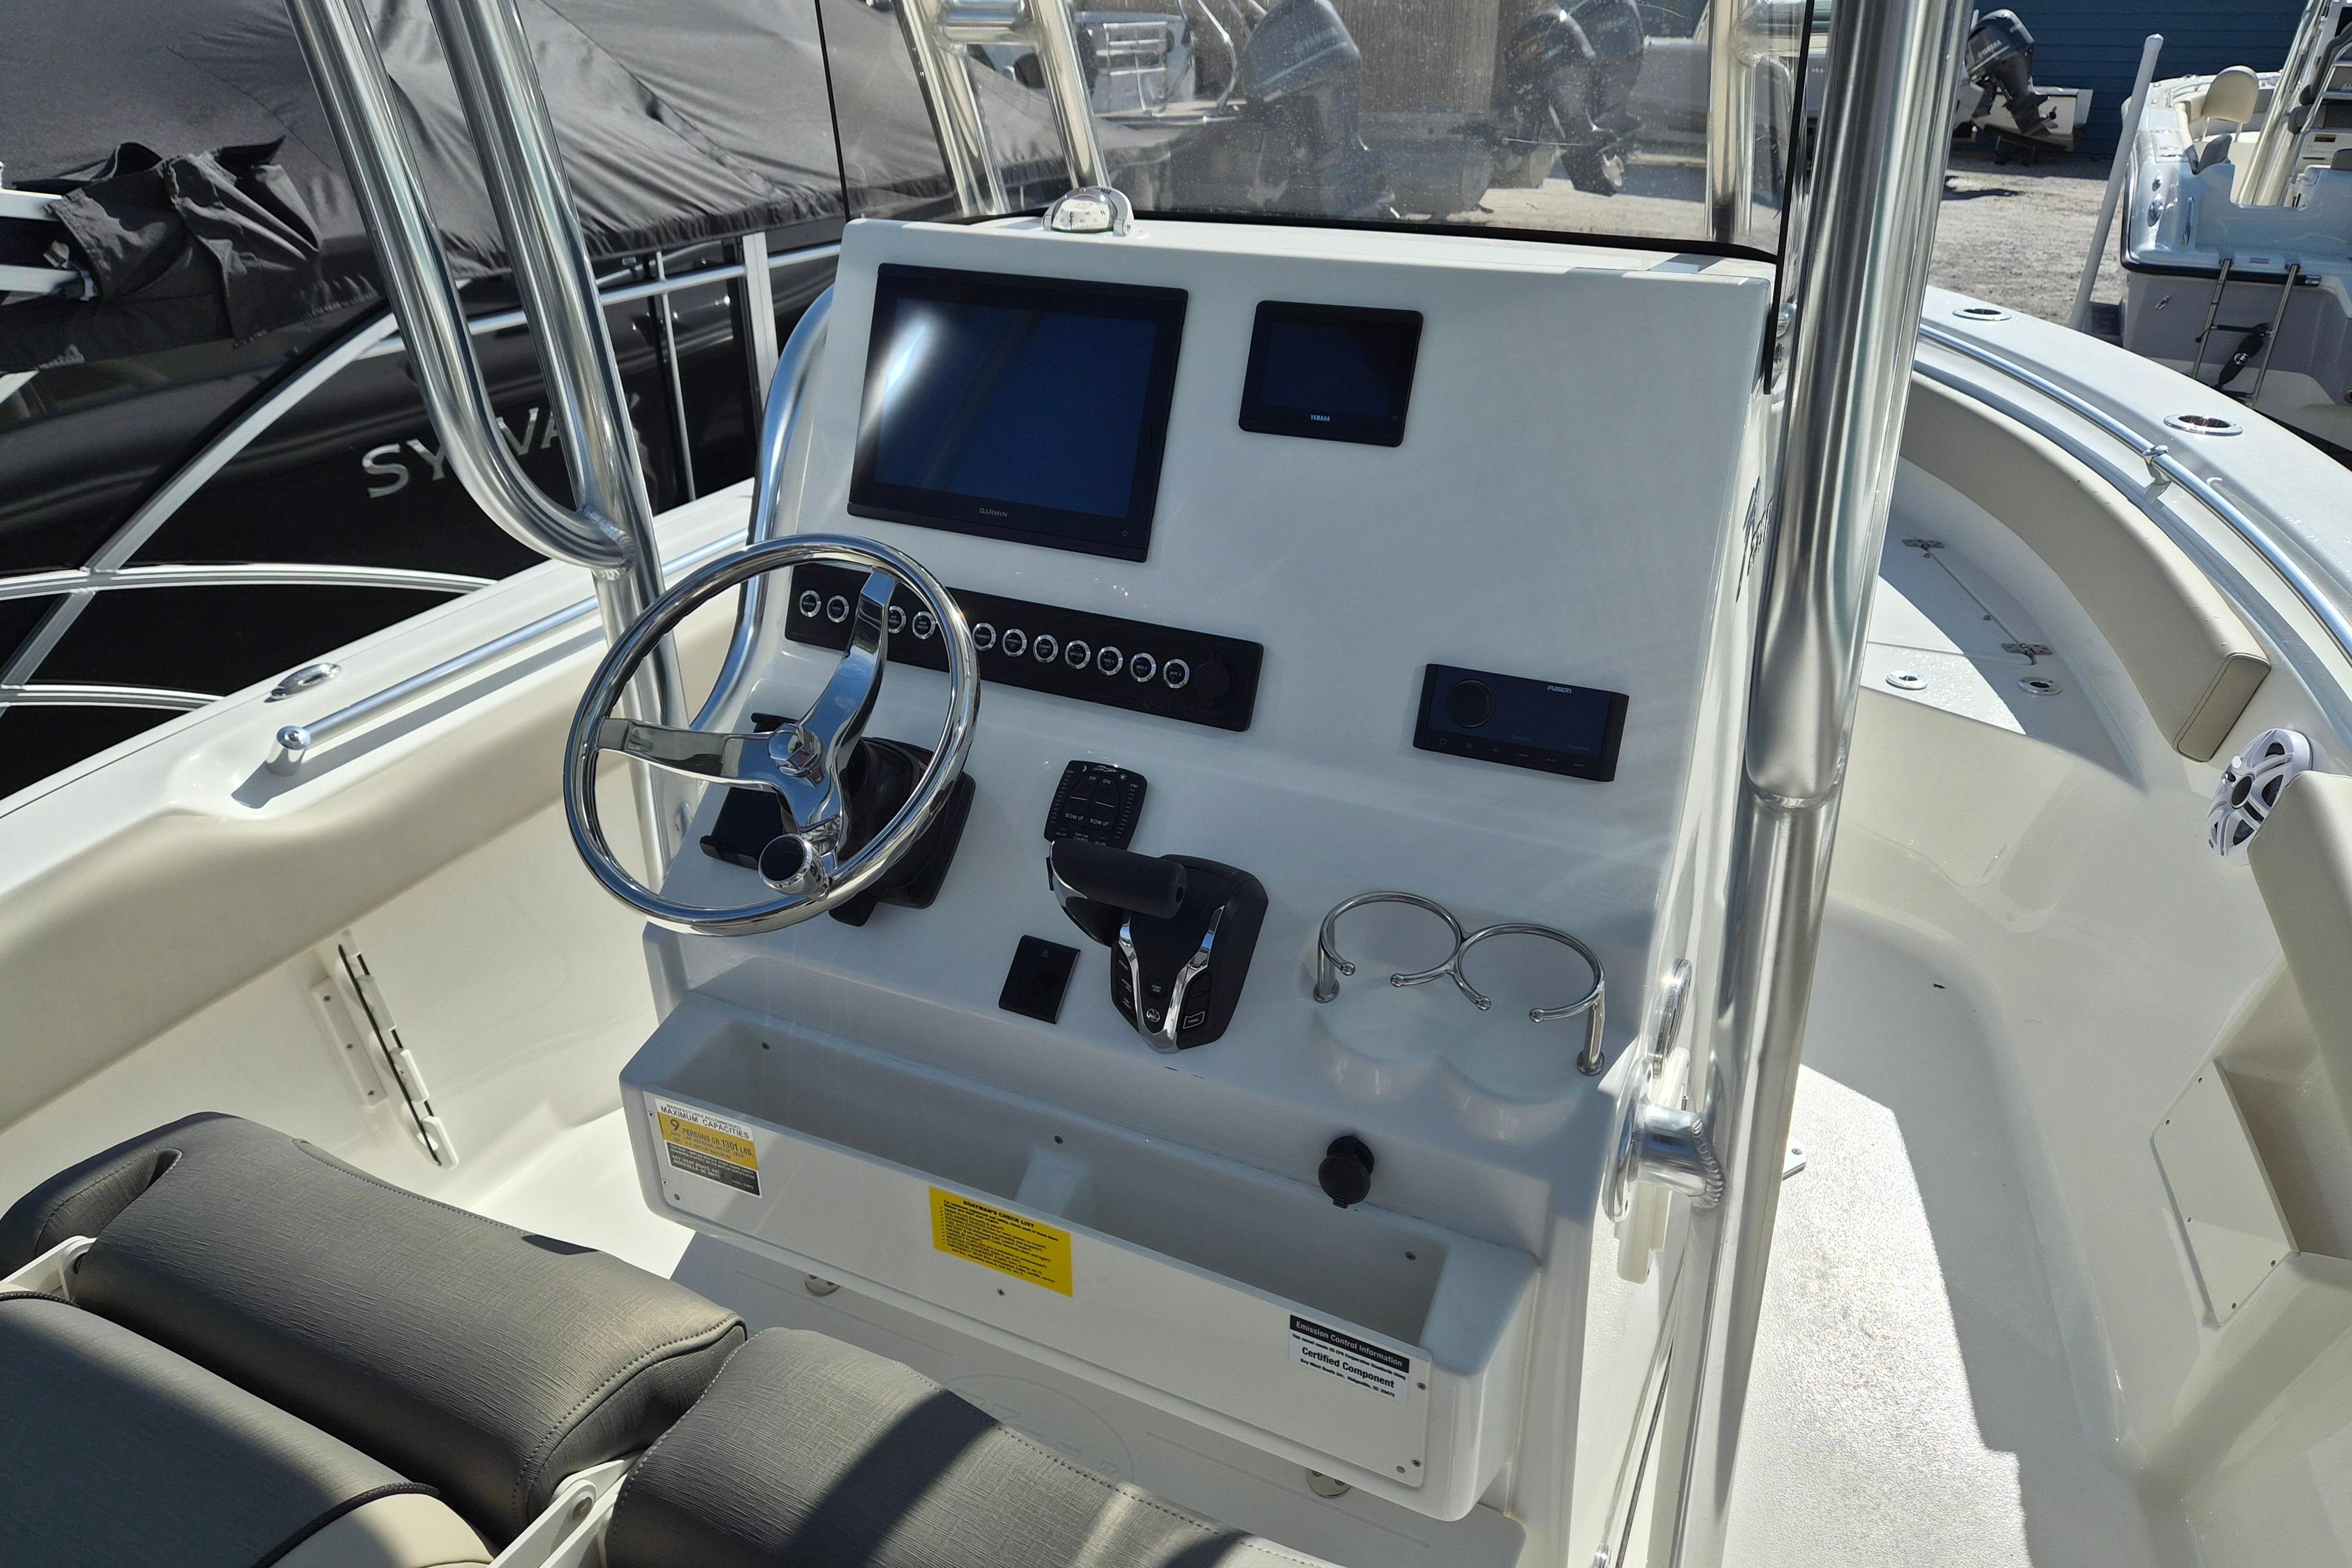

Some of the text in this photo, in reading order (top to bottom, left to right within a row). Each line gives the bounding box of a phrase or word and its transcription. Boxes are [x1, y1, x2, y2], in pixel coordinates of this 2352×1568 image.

[979, 507, 1008, 517] GARMIN
[660, 1105, 749, 1139] MAXIMUM CAPACITIES
[666, 1103, 741, 1129] MANUFACTURER RECOMMENDED
[669, 1118, 680, 1131] 9
[681, 1127, 710, 1142] PERSONS
[711, 1136, 720, 1145] OR
[721, 1138, 738, 1151] 1301
[739, 1146, 754, 1156] LBS.
[963, 1200, 997, 1216] BOATMAN'S
[998, 1212, 1019, 1223] CHECK
[1021, 1219, 1034, 1228] LIST
[1296, 1320, 1402, 1367] Emission Control Information
[1302, 1346, 1395, 1389] Certified Component
[1309, 1361, 1321, 1369] West
